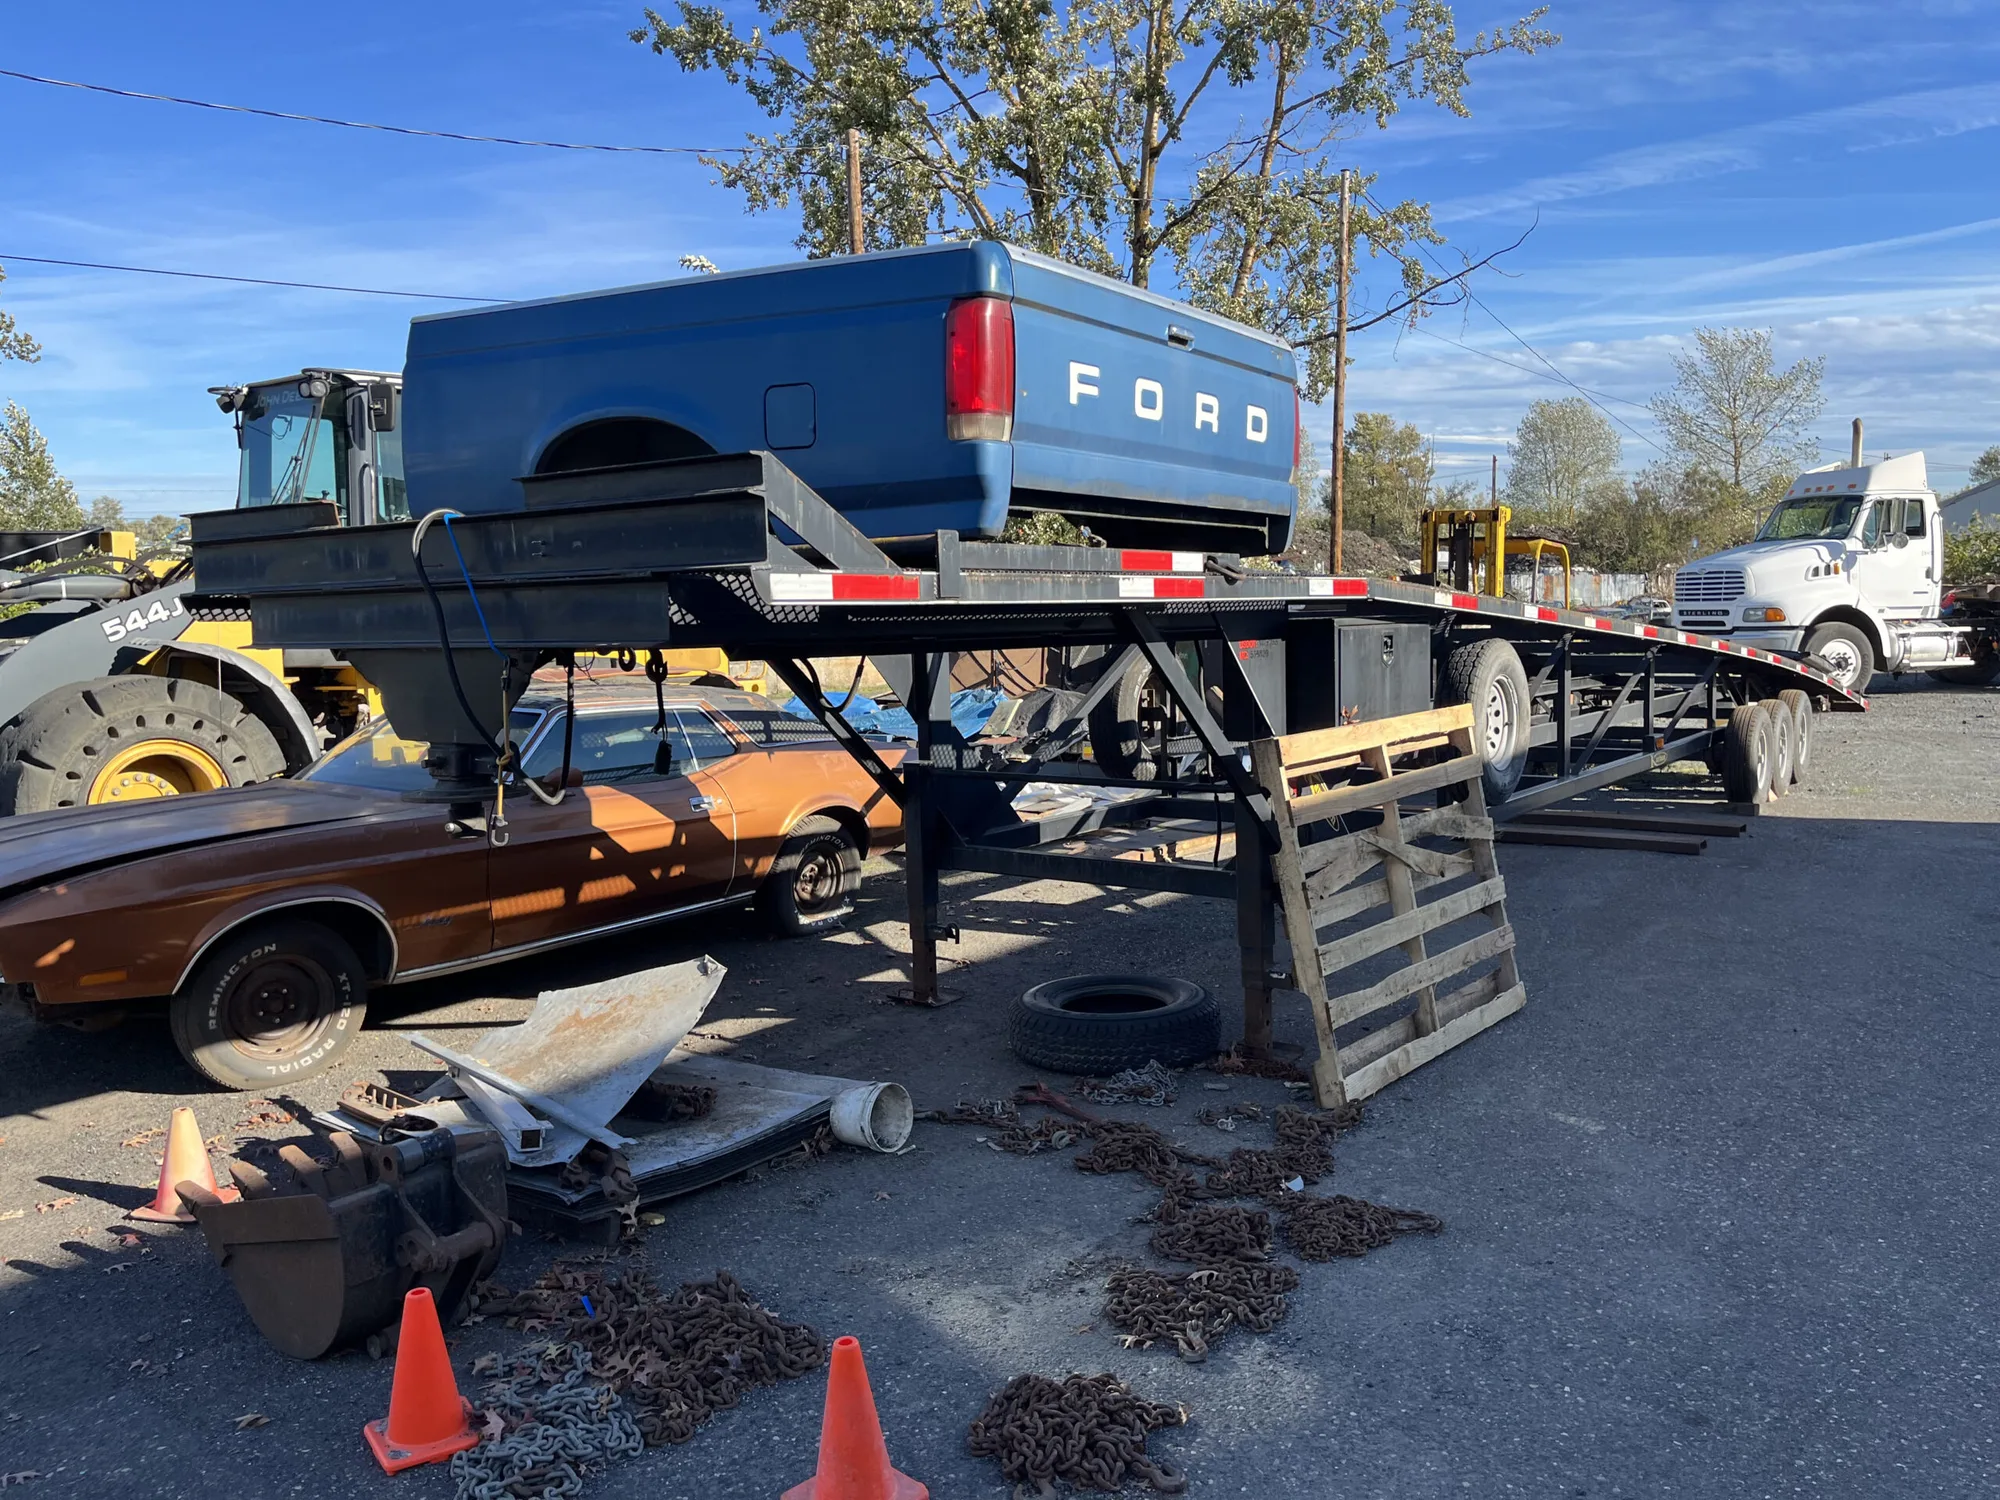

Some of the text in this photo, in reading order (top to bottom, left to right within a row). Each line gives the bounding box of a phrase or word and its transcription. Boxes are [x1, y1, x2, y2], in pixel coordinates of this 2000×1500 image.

[253, 390, 303, 409] JOHN DEE
[1069, 361, 1268, 443] FORD
[101, 596, 184, 643] 544J
[1682, 609, 1724, 617] STERLING
[208, 943, 276, 1029] REMINGTON
[267, 972, 352, 1076] XT-120 RADIAL
